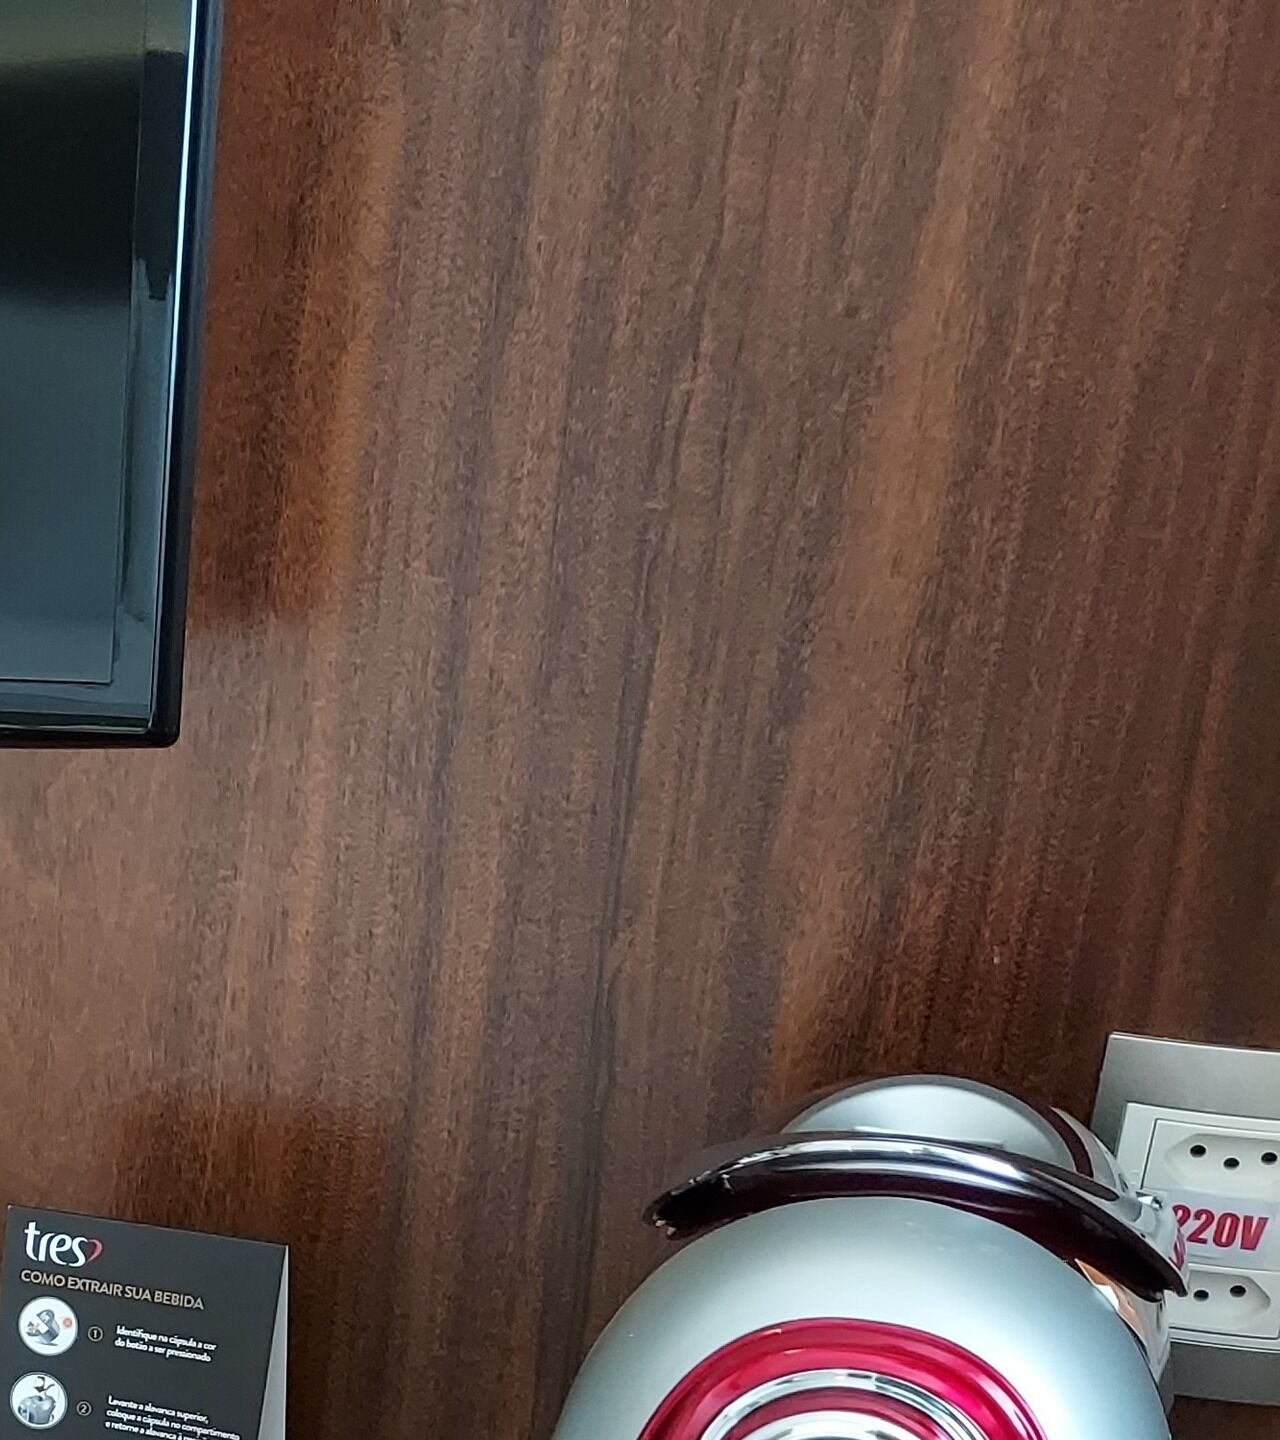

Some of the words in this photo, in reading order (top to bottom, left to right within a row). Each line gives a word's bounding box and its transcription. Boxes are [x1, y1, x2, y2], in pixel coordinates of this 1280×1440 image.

[24, 1221, 91, 1268] tres
[20, 1269, 66, 1287] COMO
[67, 1276, 124, 1298] EXTRAIR
[124, 1285, 152, 1302] SUA
[154, 1290, 205, 1311] BEBIDA
[114, 1337, 126, 1347] do
[125, 1338, 148, 1351] botão
[154, 1345, 166, 1354] ser
[166, 1348, 211, 1362] pressionado
[116, 1325, 158, 1342] Identifique
[169, 1335, 197, 1347] cápsula
[203, 1342, 217, 1351] cor
[107, 1394, 139, 1410] Levante
[144, 1402, 176, 1417] alavanca
[106, 1408, 137, 1421] coloque
[142, 1414, 170, 1429] cápsula
[170, 1421, 181, 1429] no
[181, 1424, 240, 1440] compartimento
[145, 1427, 176, 1440] alavanca
